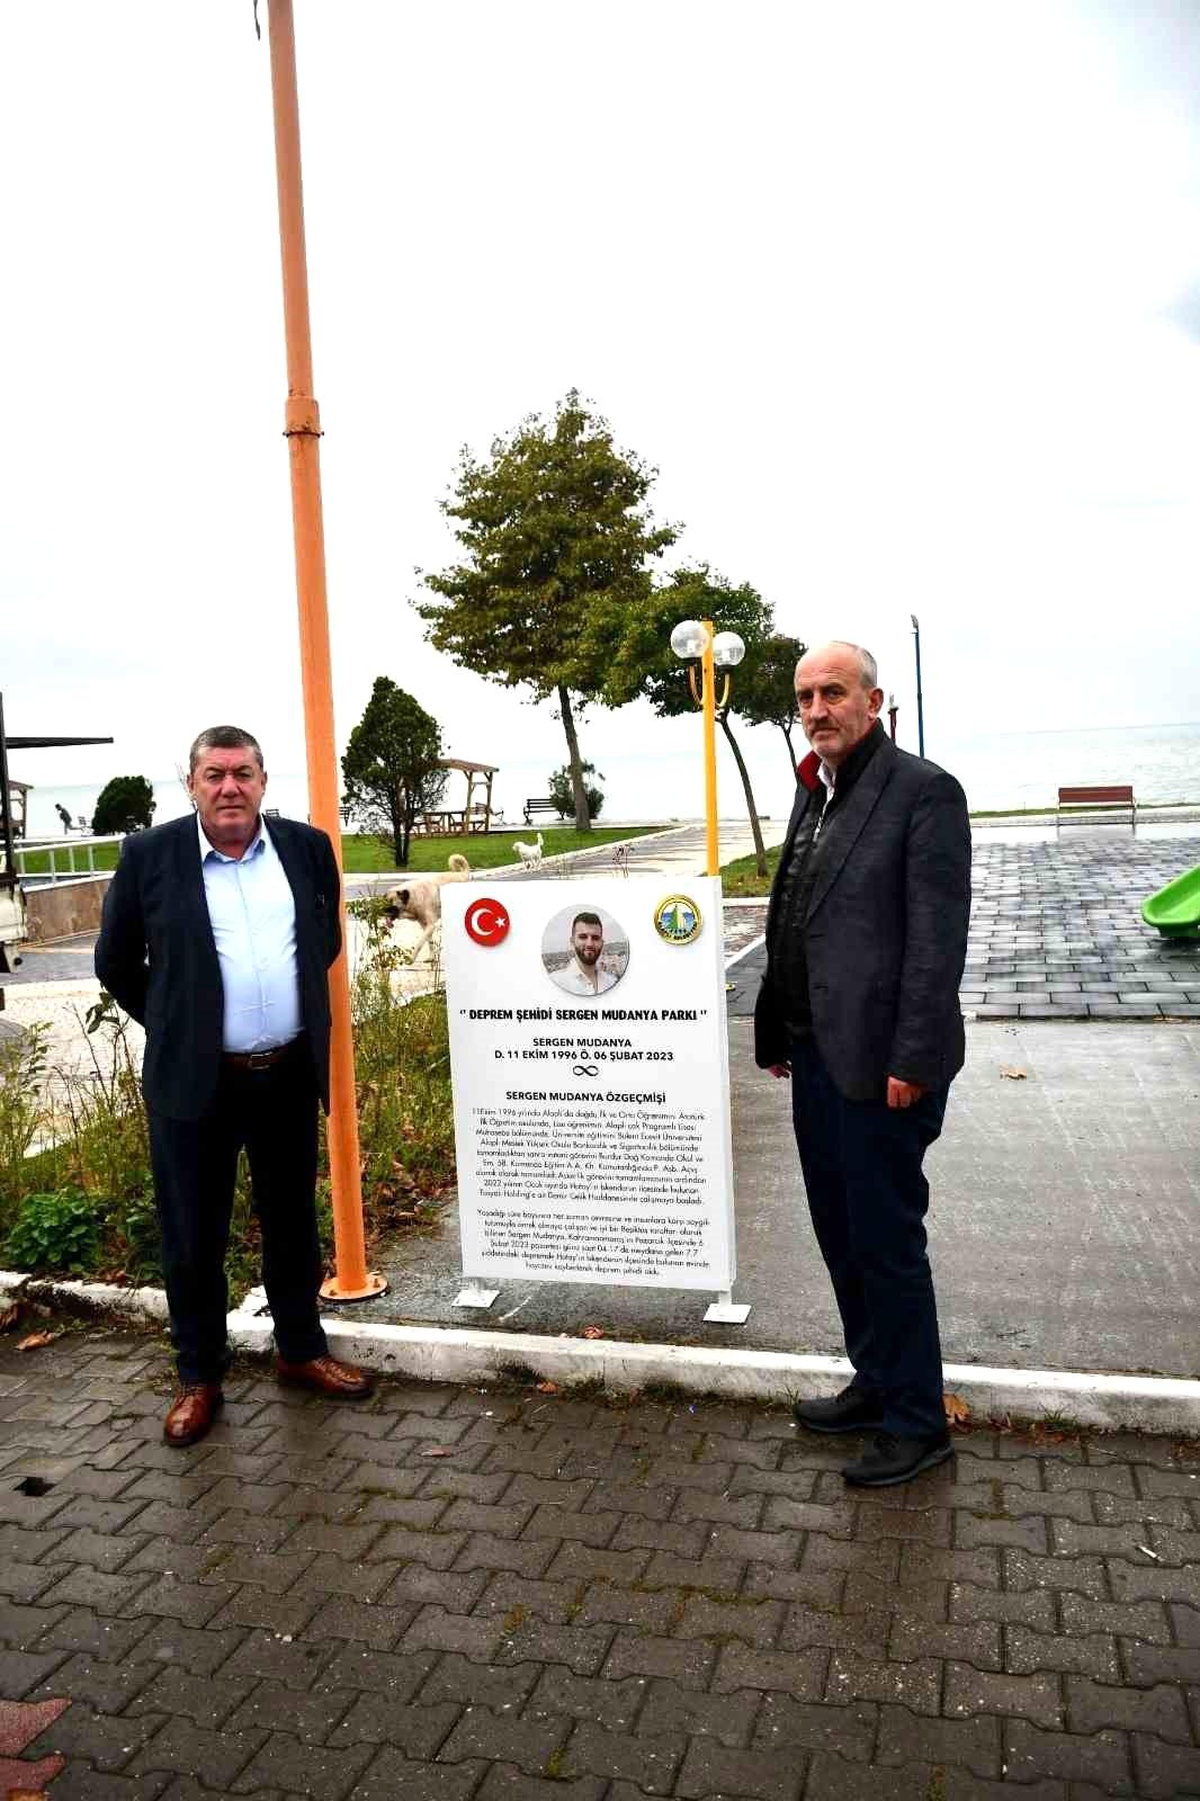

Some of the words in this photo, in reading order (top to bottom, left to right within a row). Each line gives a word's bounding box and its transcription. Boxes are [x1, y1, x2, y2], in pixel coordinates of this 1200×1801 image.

[469, 1009, 513, 1021] DEPREM
[516, 1006, 553, 1023] ŞEHİDİ
[556, 1009, 598, 1021] SERGEN
[601, 1009, 659, 1021] MUDANYA
[661, 1010, 698, 1021] PARKI
[533, 1037, 574, 1047] SERGEN
[576, 1037, 632, 1048] MUDANYA
[494, 1050, 505, 1059] D.
[508, 1051, 519, 1059] 11
[522, 1048, 549, 1060] EKİM
[552, 1050, 578, 1060] 1996
[580, 1047, 592, 1060] Ö.
[594, 1051, 607, 1061] 06
[610, 1050, 644, 1063] ŞUBAT
[646, 1051, 674, 1061] 2023
[506, 1091, 547, 1100] SERGEN
[549, 1092, 604, 1102] MUDANYA
[606, 1091, 667, 1105] ÖZGEÇMİŞİ
